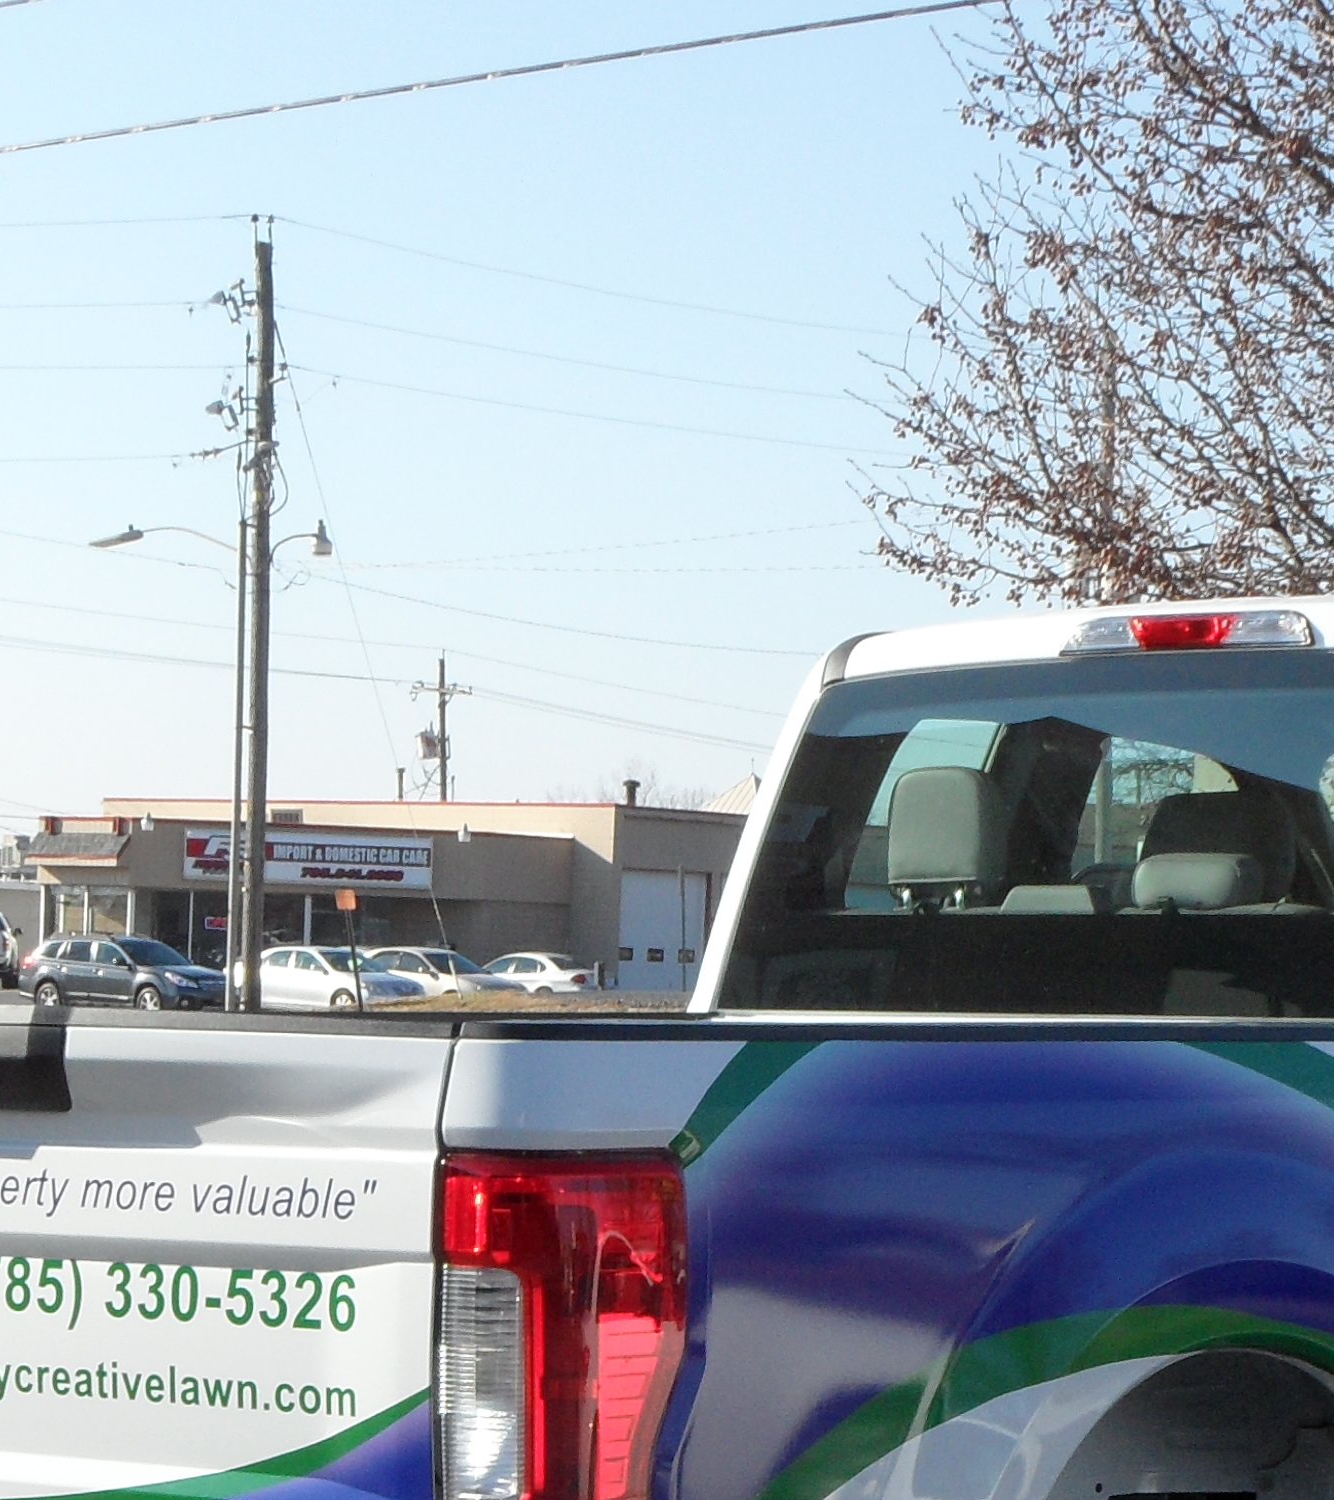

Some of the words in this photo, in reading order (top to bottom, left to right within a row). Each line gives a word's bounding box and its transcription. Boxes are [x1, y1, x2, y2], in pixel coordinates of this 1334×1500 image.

[273, 844, 313, 861] IMPORT
[315, 847, 322, 861] &
[324, 845, 377, 864] DOMESTIC
[378, 848, 400, 865] CAR
[404, 849, 428, 866] CARE
[80, 1177, 176, 1212] more
[105, 1263, 358, 1332] 330-5326
